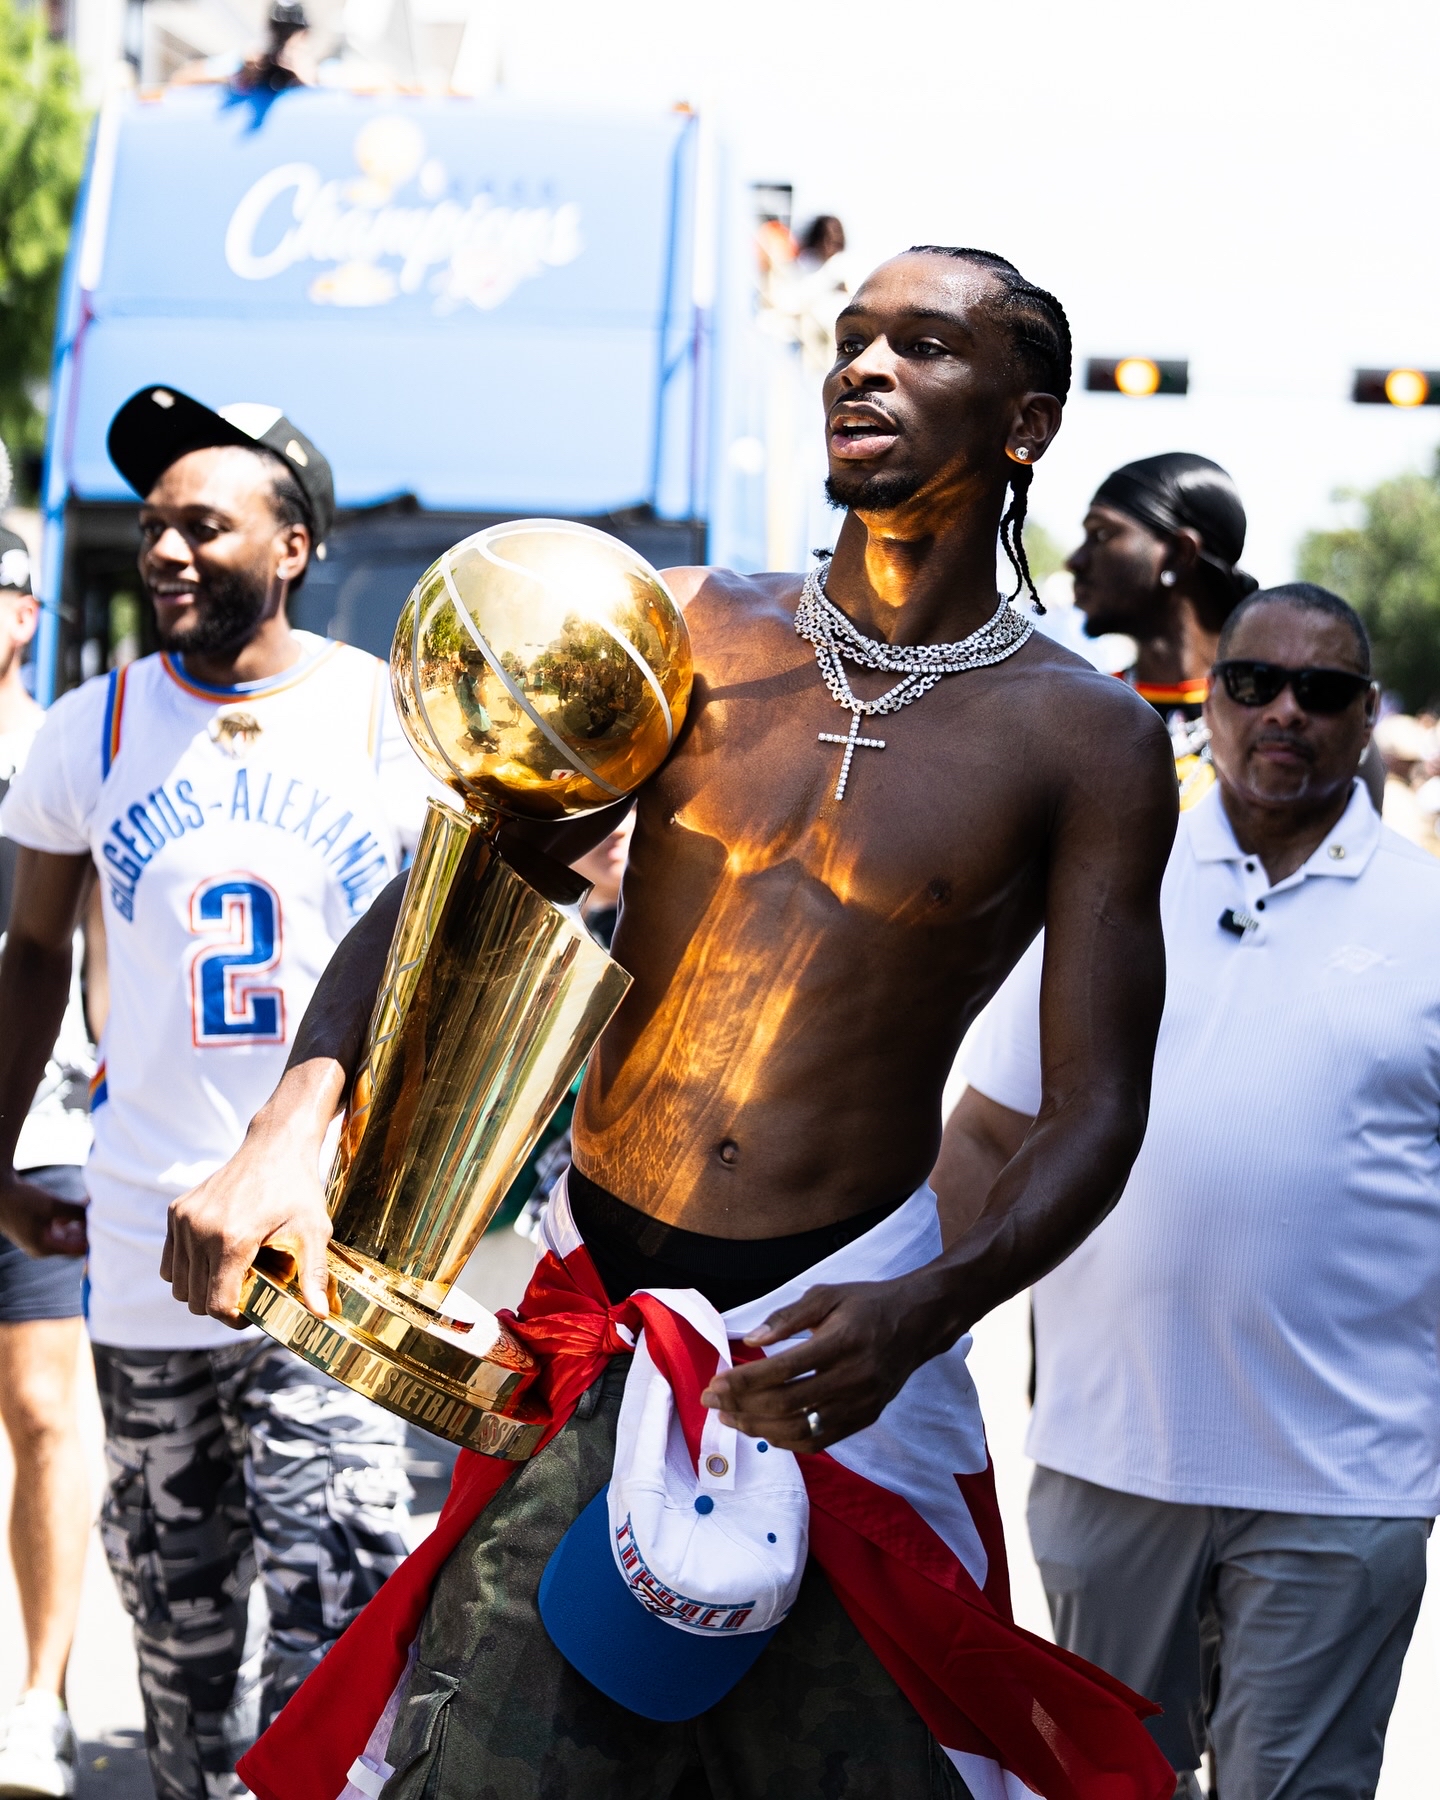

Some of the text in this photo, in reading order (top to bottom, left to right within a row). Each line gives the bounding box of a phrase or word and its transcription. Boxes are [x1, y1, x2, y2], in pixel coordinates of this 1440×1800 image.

[188, 871, 284, 1047] 2
[251, 1286, 352, 1370] NATIONAL
[348, 1352, 473, 1436] BASKETBALL
[617, 1523, 753, 1628] THUNDER
